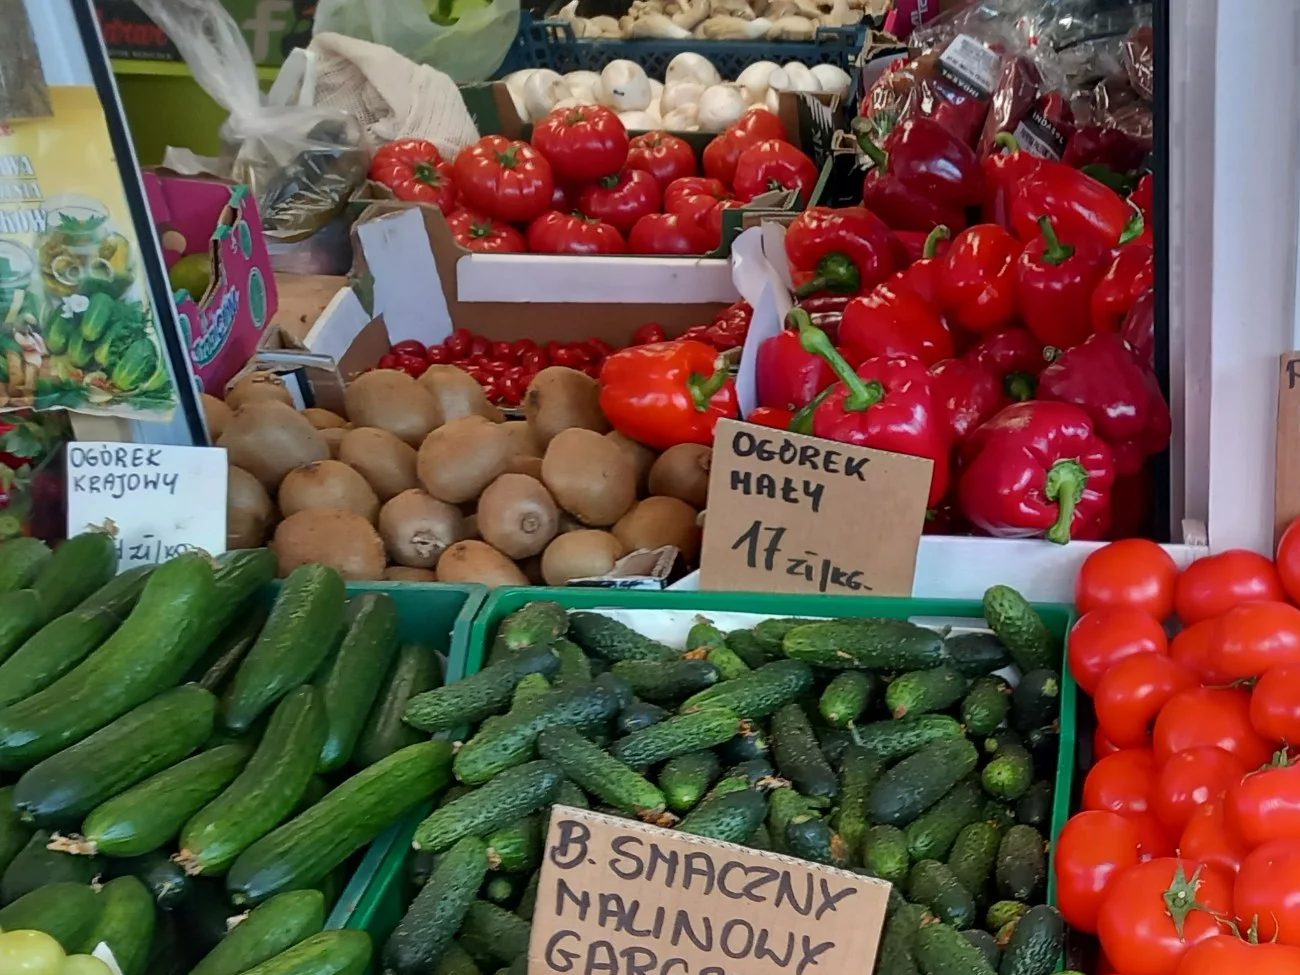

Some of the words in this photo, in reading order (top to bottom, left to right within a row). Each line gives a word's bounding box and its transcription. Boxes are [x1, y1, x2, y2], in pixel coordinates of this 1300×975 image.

[70, 444, 162, 468] OGÓREK
[732, 430, 871, 482] OGÓREK
[73, 473, 179, 499] KRAJOWY
[730, 470, 825, 513] MAŁY
[550, 819, 597, 870] B.
[609, 835, 858, 921] SMACZNY
